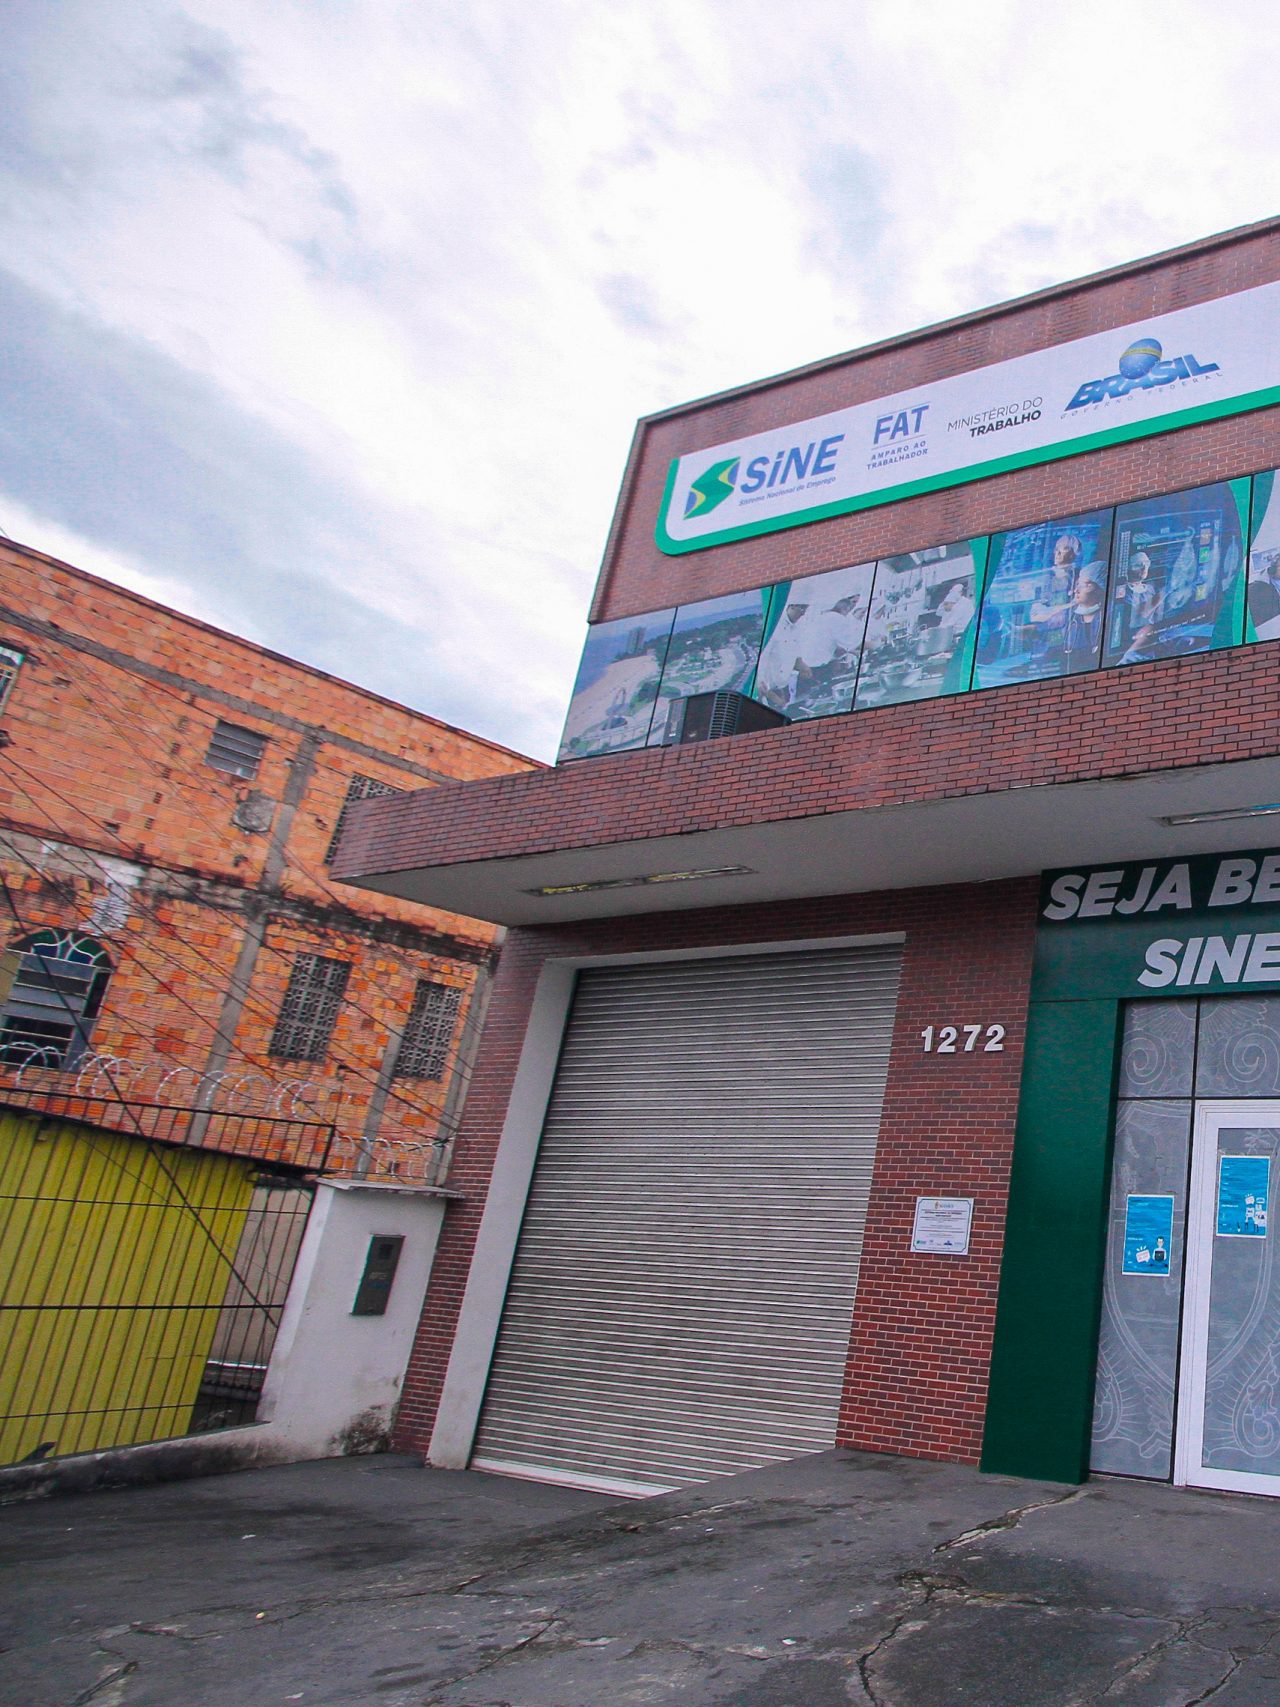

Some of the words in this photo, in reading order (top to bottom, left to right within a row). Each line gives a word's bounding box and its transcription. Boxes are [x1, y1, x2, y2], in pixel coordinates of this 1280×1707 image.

[1064, 353, 1221, 412] BRASIL
[1148, 372, 1224, 394] FEDERAL
[873, 404, 929, 445] FAT
[947, 403, 1019, 432] MINISTÉRIO
[1022, 396, 1043, 411] DO
[969, 410, 1042, 438] TRABALHO
[867, 448, 928, 470] TRABALHADOR
[871, 445, 909, 461] AMPARO
[914, 440, 926, 449] AO
[1042, 866, 1191, 920] SEJA
[921, 1024, 1005, 1053] 1272
